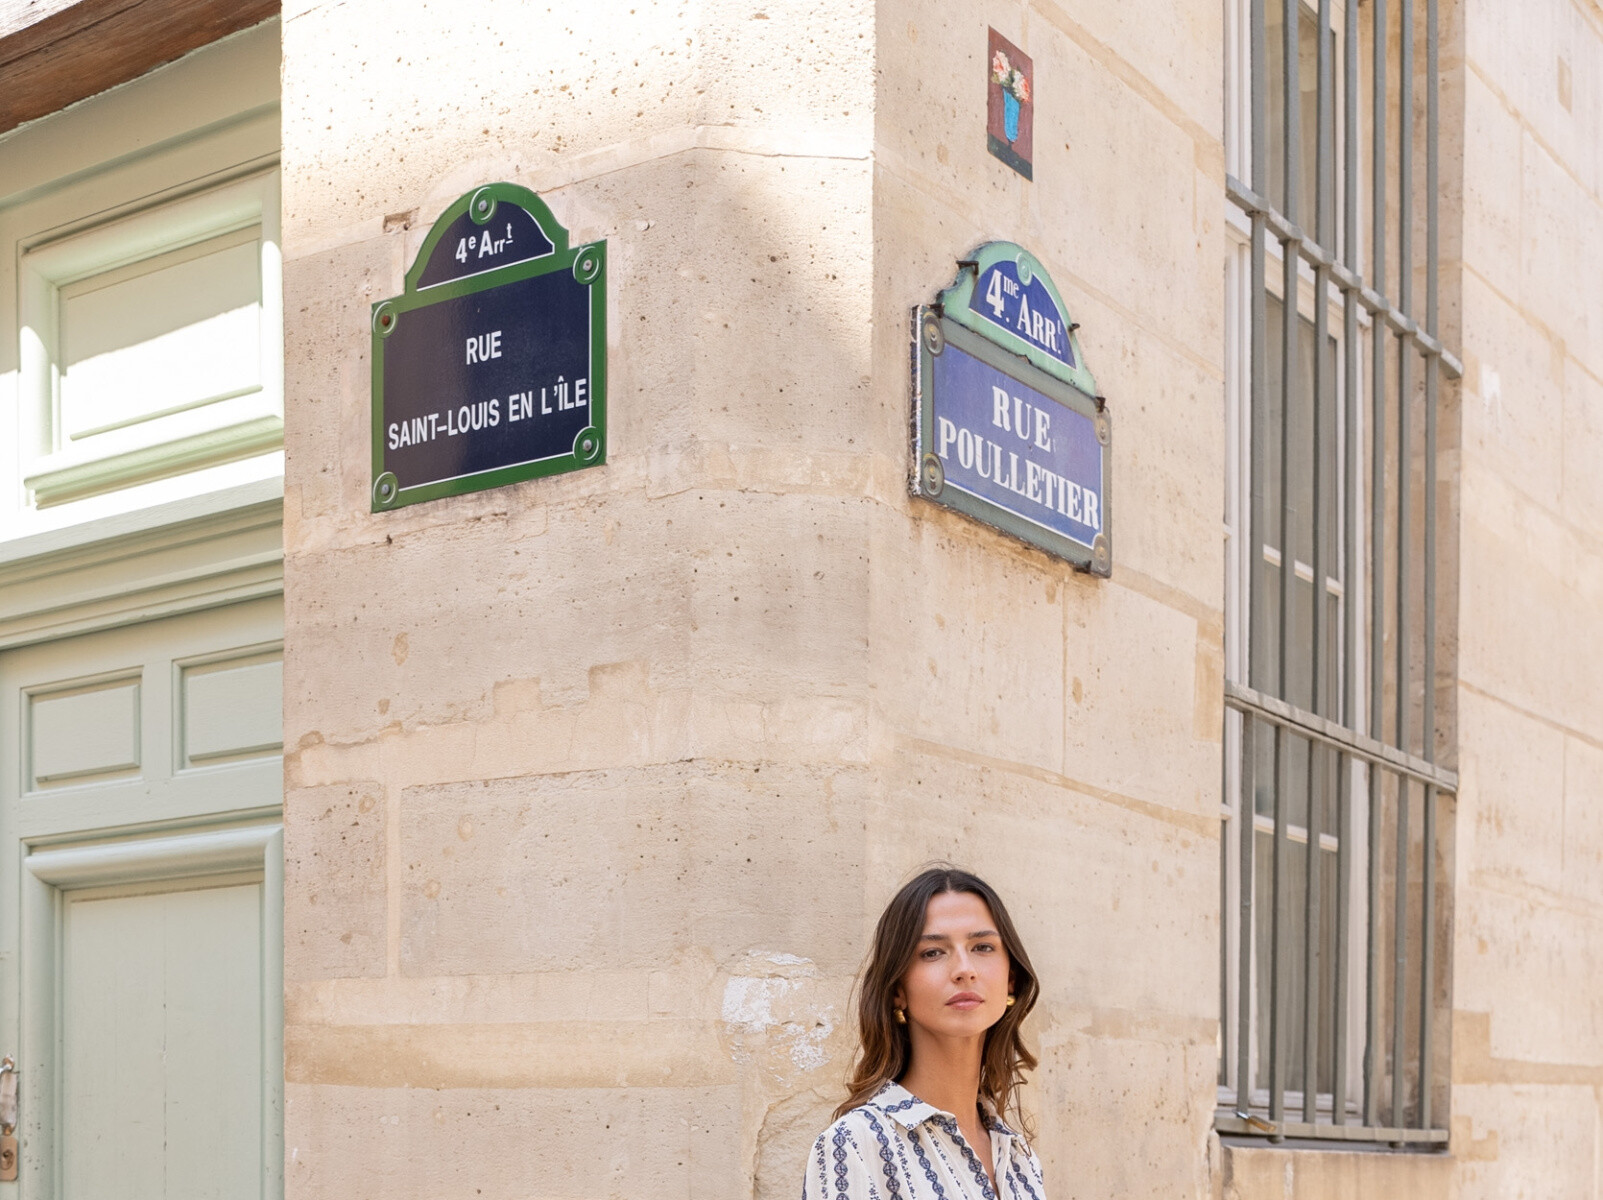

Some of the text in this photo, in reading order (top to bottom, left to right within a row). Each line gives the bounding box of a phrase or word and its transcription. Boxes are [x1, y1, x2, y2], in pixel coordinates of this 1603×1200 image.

[455, 237, 476, 263] 4e
[466, 330, 502, 365] RUE
[388, 375, 587, 450] SAINT-LOUIS EN L'ÎLE
[992, 385, 1051, 453] RUE
[938, 416, 1100, 530] POULLETIER
